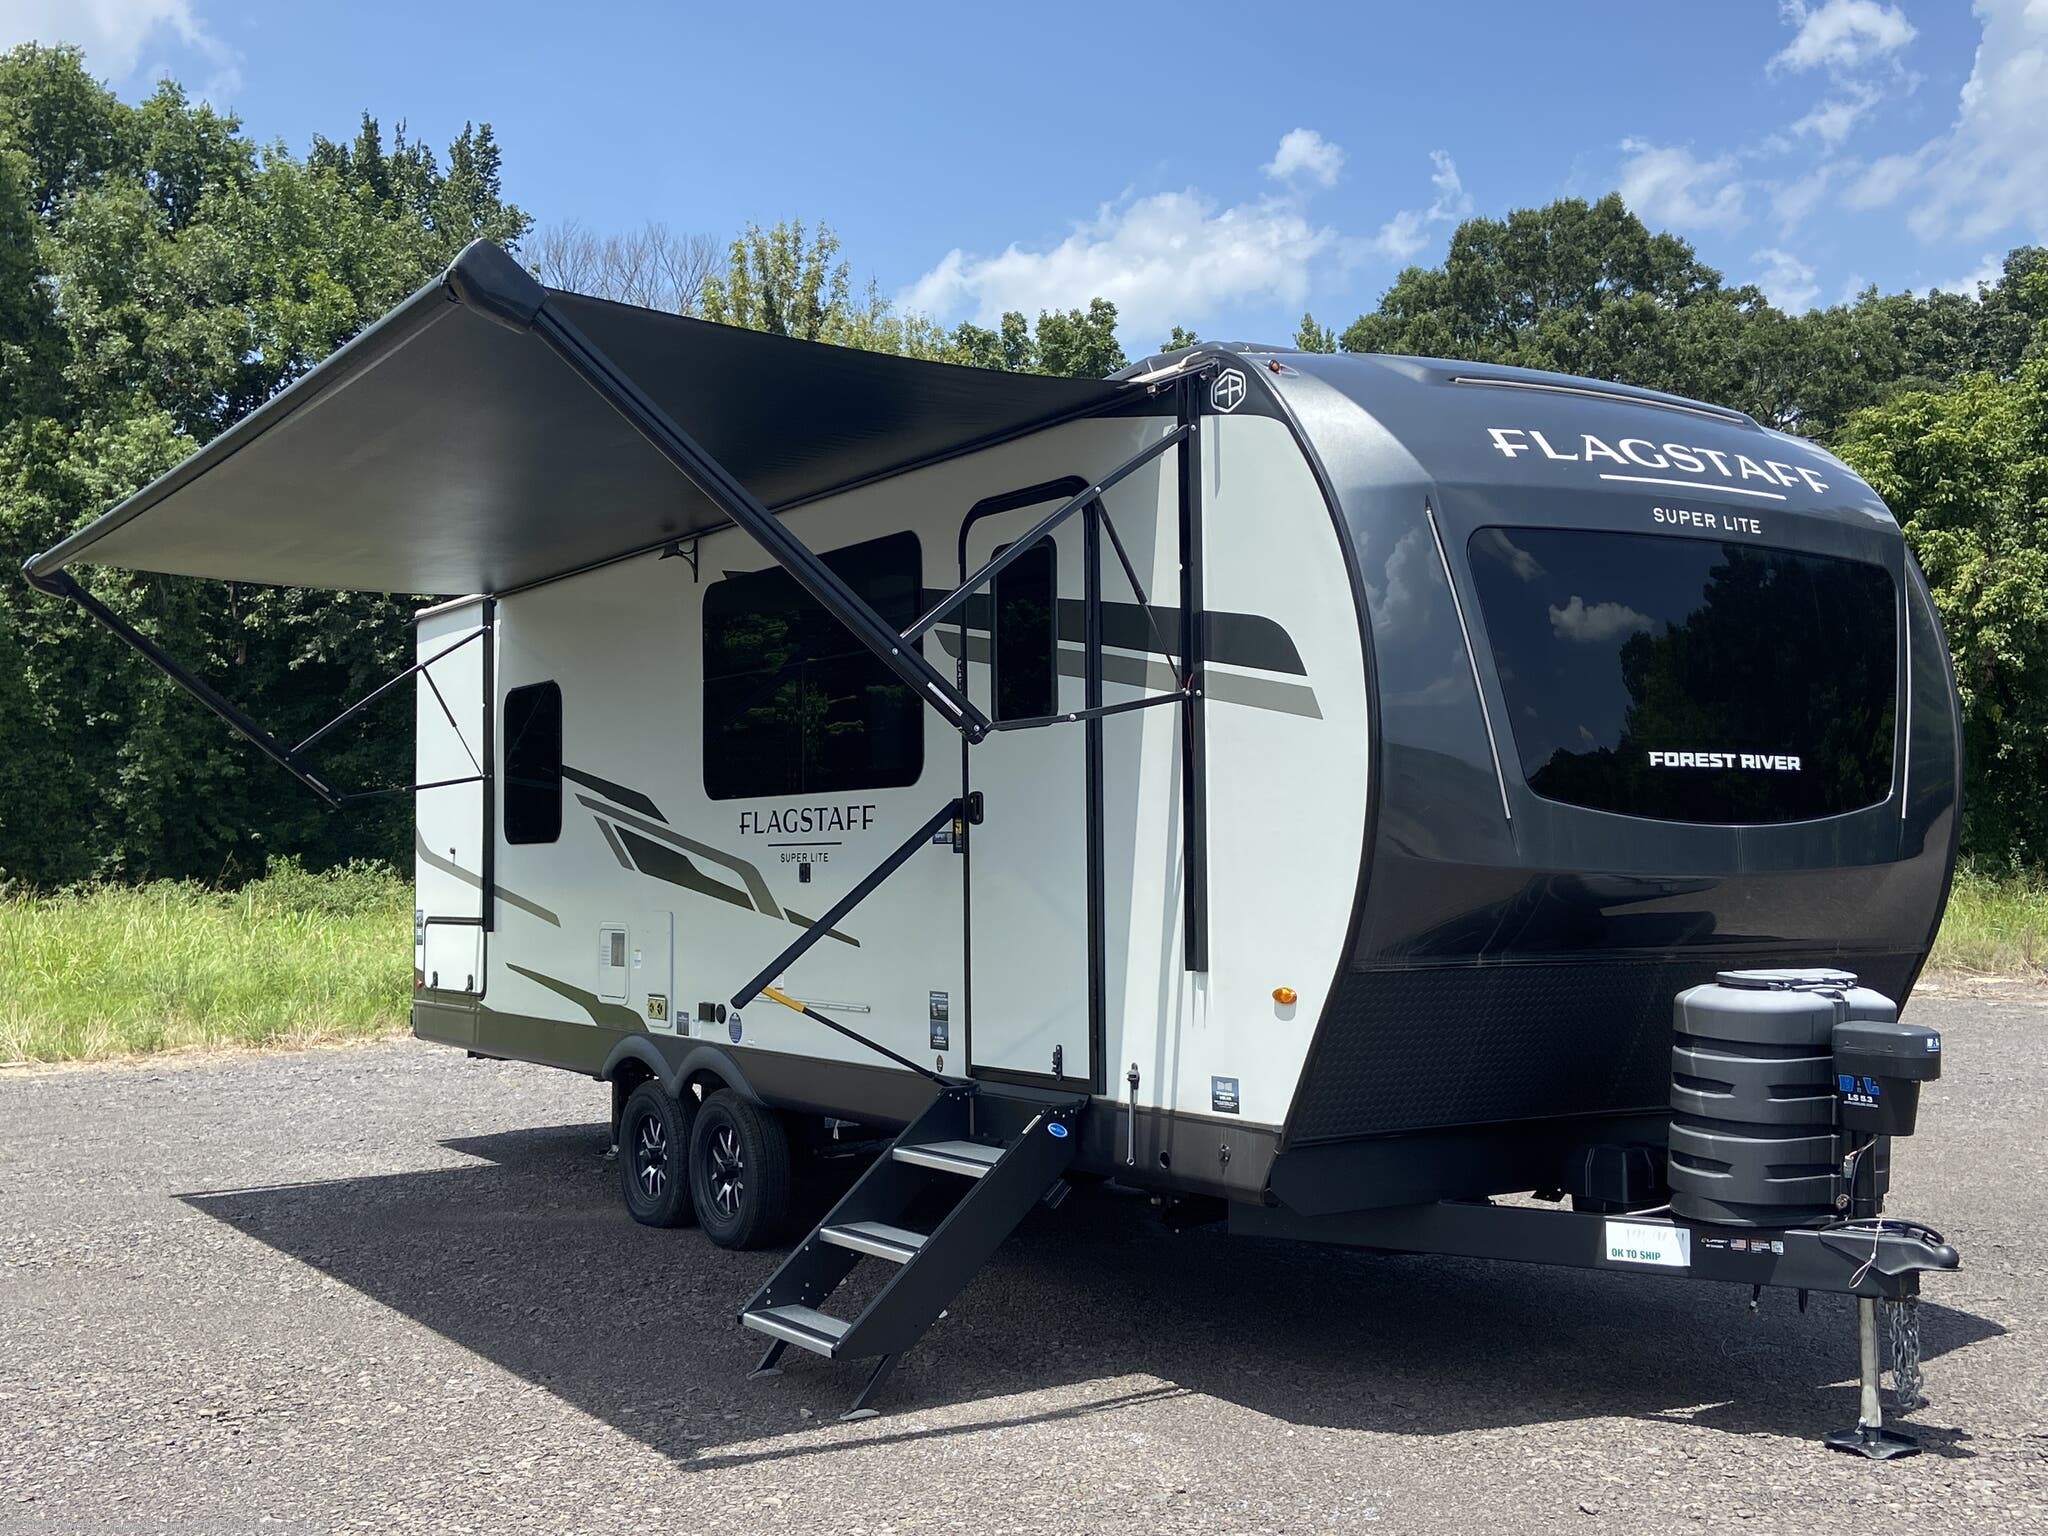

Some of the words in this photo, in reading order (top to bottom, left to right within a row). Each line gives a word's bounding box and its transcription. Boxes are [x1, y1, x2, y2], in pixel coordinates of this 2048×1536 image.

[1487, 428, 1830, 494] FLAGSTAFF
[1653, 507, 1716, 528] SUPER
[1723, 515, 1762, 534] LITE
[1648, 752, 1736, 768] FOREST
[1740, 754, 1801, 771] RIVER
[739, 805, 876, 835] FLAGSTAFF
[780, 853, 807, 863] SUPER
[810, 852, 829, 863] LITE
[1611, 1248, 1624, 1258] OK
[1625, 1249, 1637, 1259] TO
[1640, 1250, 1661, 1261] SHIP
